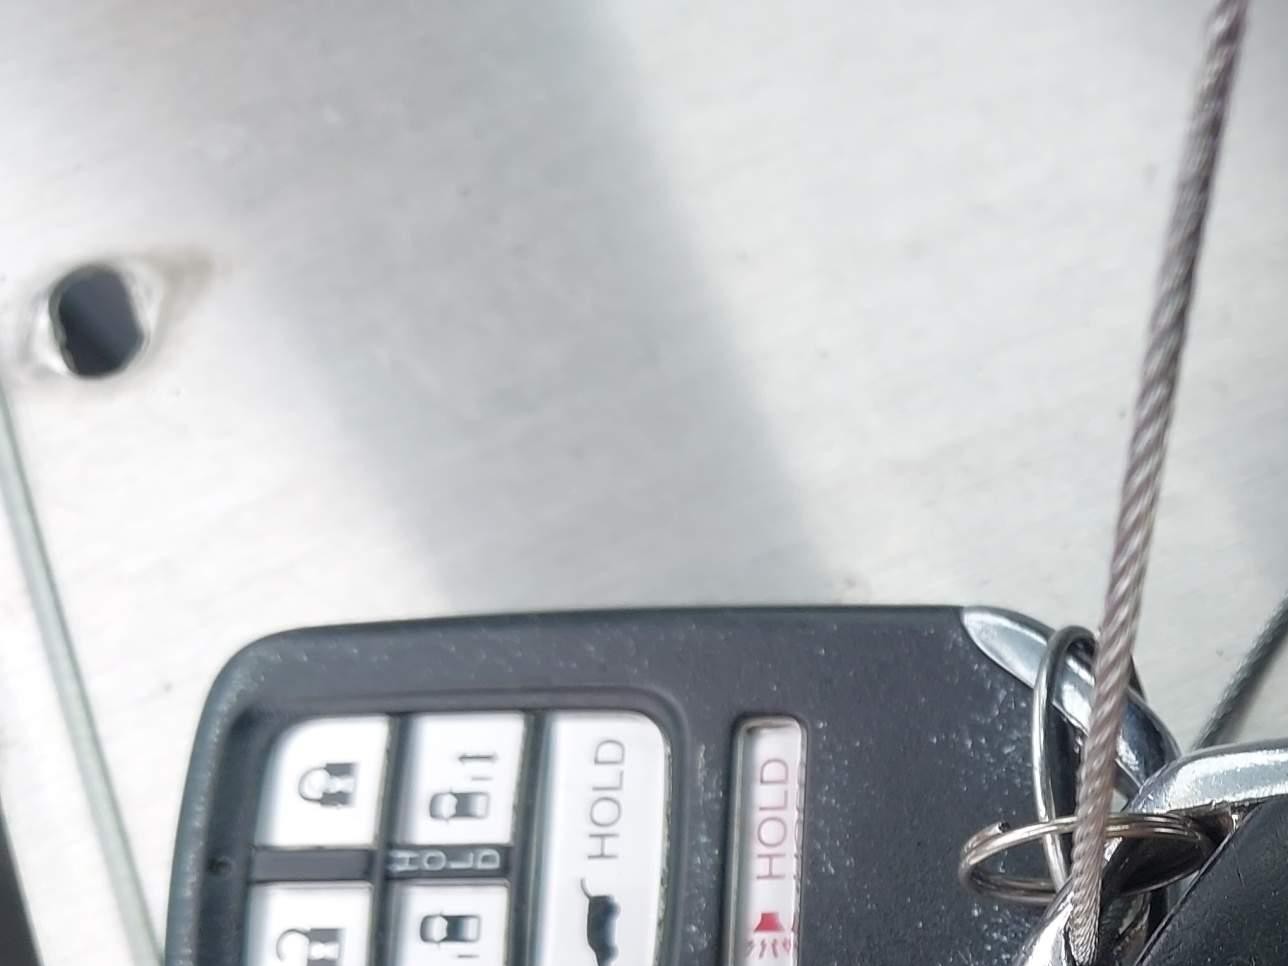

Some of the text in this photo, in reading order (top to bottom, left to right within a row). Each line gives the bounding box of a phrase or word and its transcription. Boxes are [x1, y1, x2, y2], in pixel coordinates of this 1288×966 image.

[389, 848, 500, 872] HOLD
[587, 738, 625, 860] HOLD
[755, 757, 790, 881] HOLD
